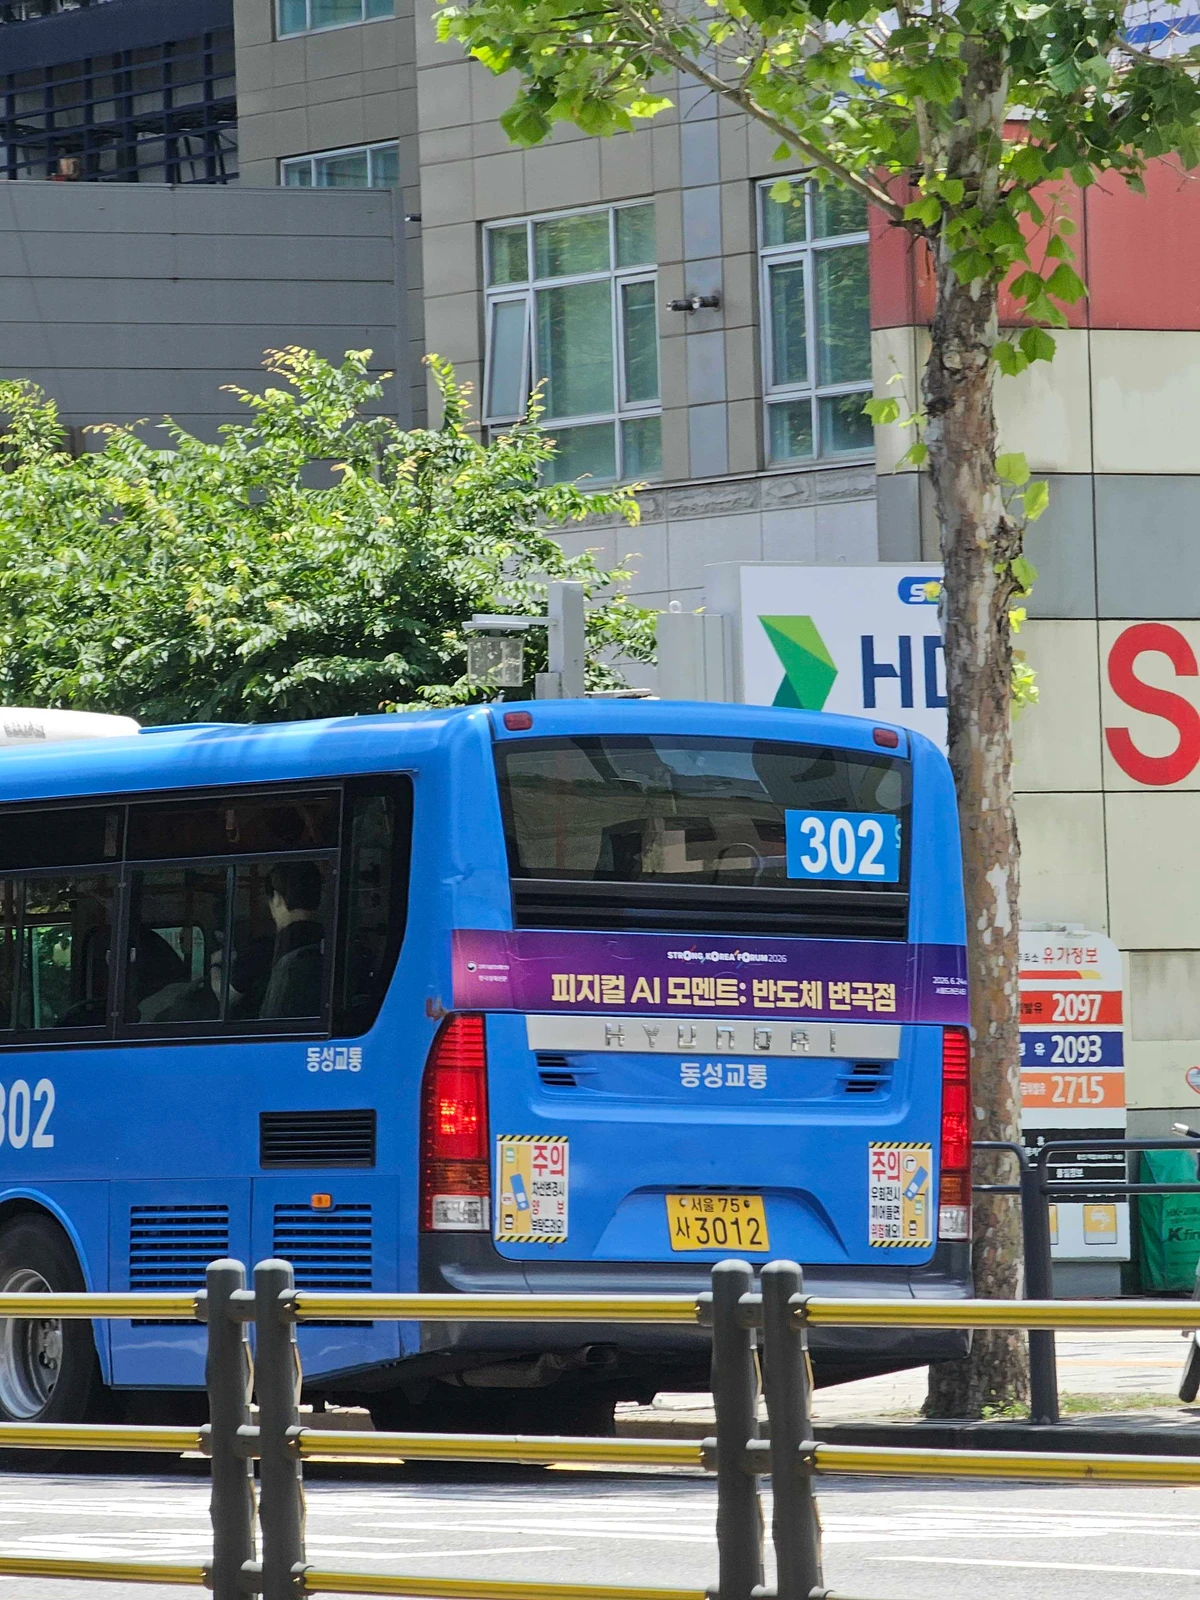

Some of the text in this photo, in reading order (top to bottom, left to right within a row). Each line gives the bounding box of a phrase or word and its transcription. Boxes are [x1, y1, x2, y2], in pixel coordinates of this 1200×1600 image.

[1105, 622, 1200, 786] S
[800, 816, 885, 875] 302
[667, 950, 703, 961] STRONG
[705, 951, 736, 962] KOREA
[737, 952, 768, 963] FORUM
[1042, 947, 1098, 965] 유가정보
[551, 973, 896, 1012] 피지컬 AI 모멘트: 반도체 변곡점
[1052, 993, 1102, 1022] 2097
[604, 1022, 836, 1053] HYUNDAI
[1051, 1034, 1102, 1063] 2093
[306, 1047, 363, 1072] 동성교통
[680, 1062, 768, 1089] 동성교통
[1051, 1075, 1104, 1104] 2715
[0, 1078, 56, 1149] 02
[533, 1145, 565, 1177] 주의
[872, 1151, 901, 1182] 주의
[871, 1186, 901, 1201] 우회전시
